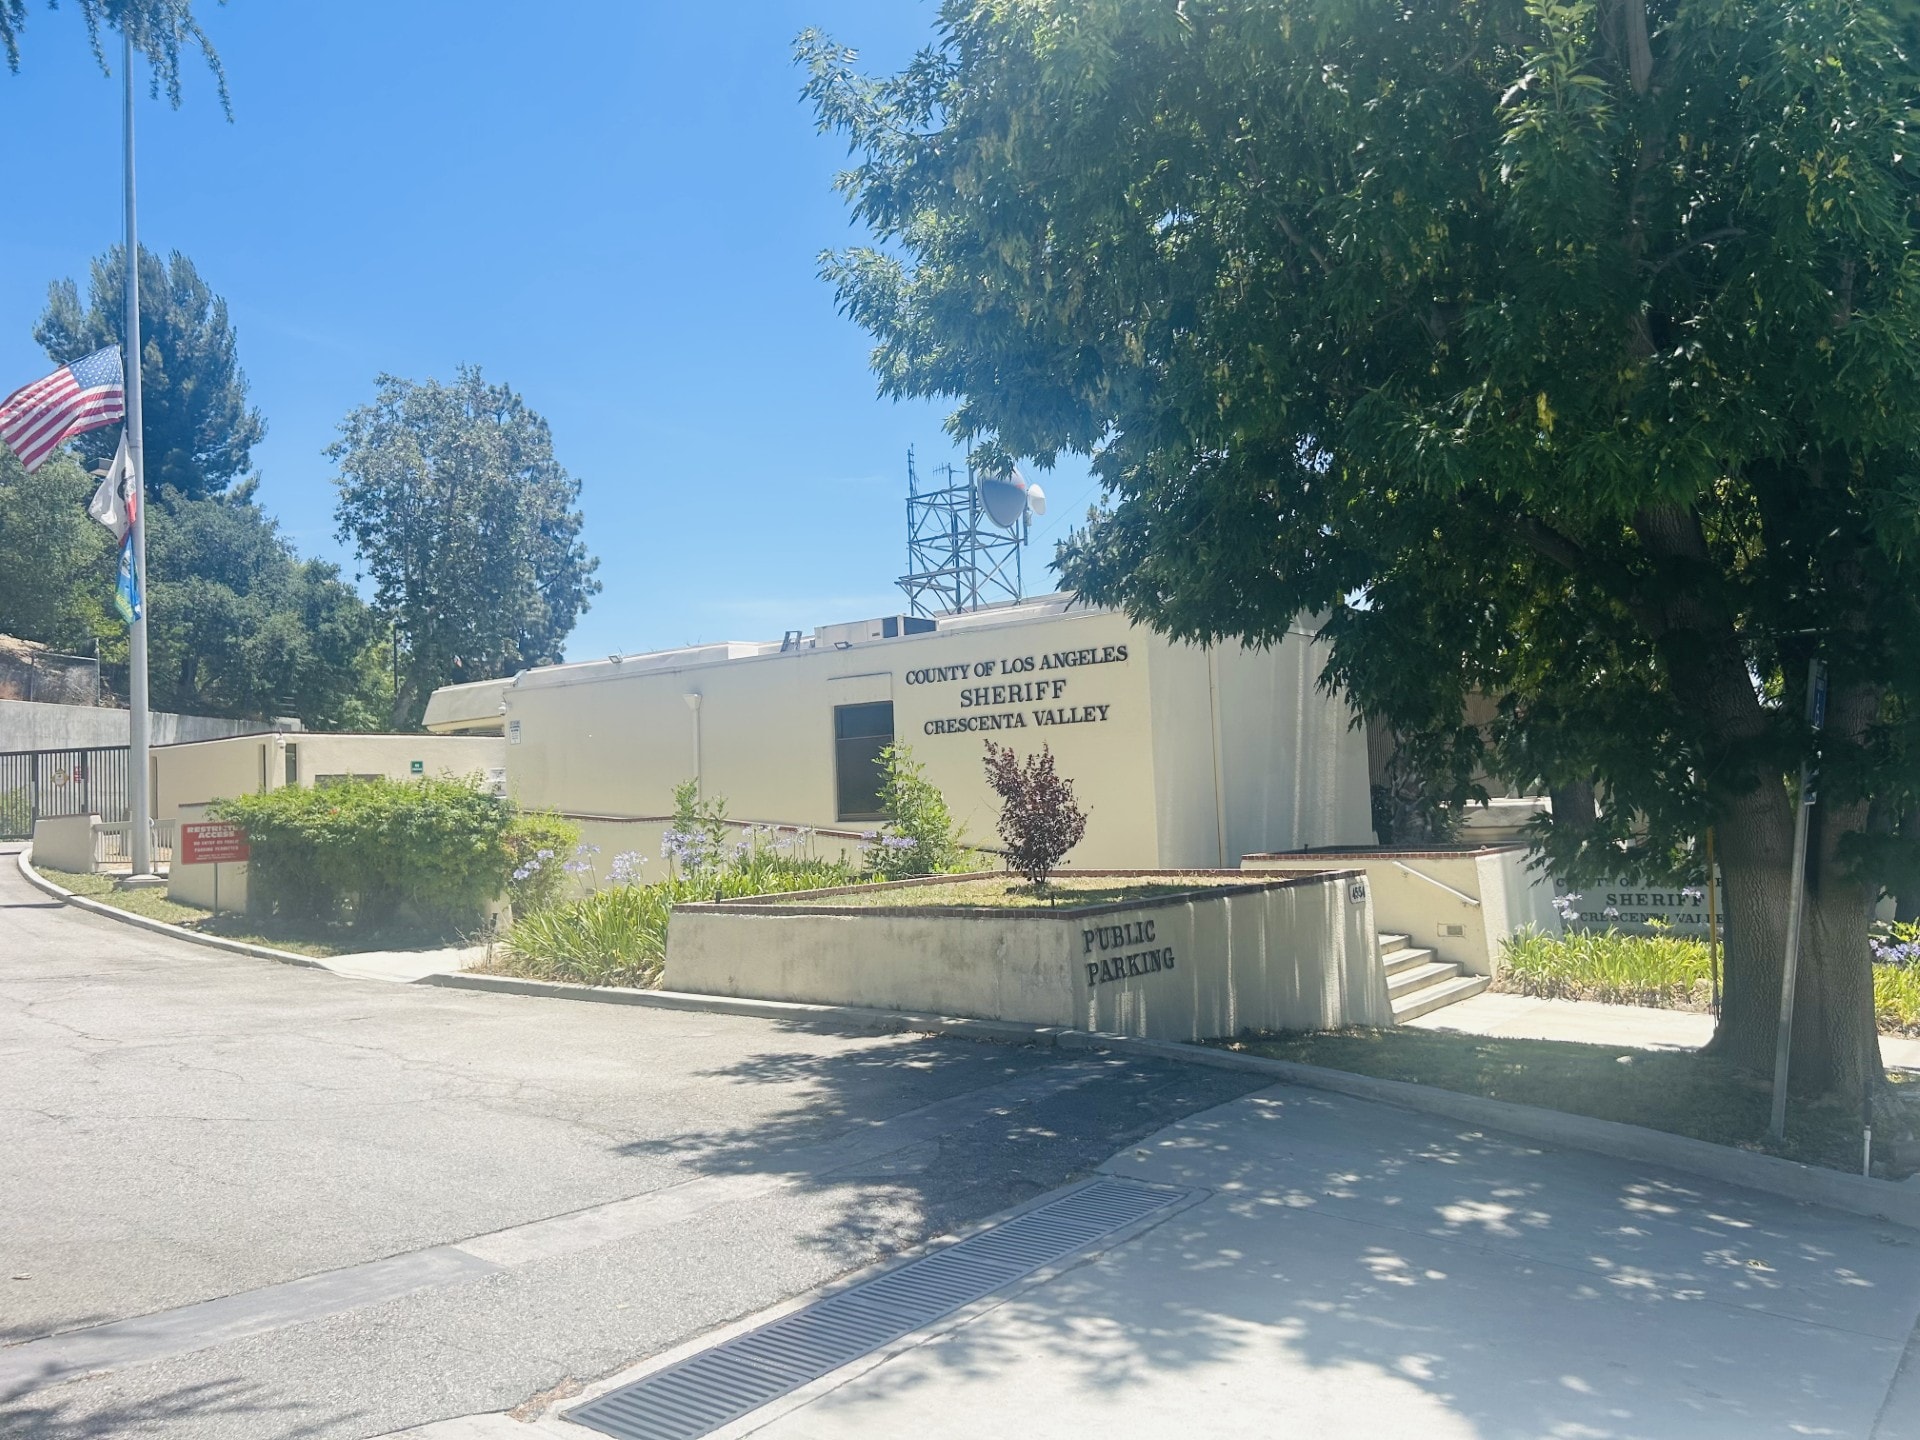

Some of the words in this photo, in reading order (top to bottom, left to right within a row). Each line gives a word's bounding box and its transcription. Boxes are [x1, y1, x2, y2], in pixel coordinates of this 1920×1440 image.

[905, 664, 970, 685] COUNTY
[973, 661, 996, 677] OF
[1001, 656, 1035, 675] LOS
[1039, 645, 1128, 670] ANGELES
[960, 679, 1067, 708] SHERIFF
[923, 712, 1027, 735] CRESCENTA
[1032, 704, 1110, 727] VALLEY
[198, 831, 235, 839] ACCESS
[1606, 893, 1705, 907] SHERIFF
[1083, 920, 1156, 954] PUBLIC
[1086, 947, 1175, 987] PARKING
